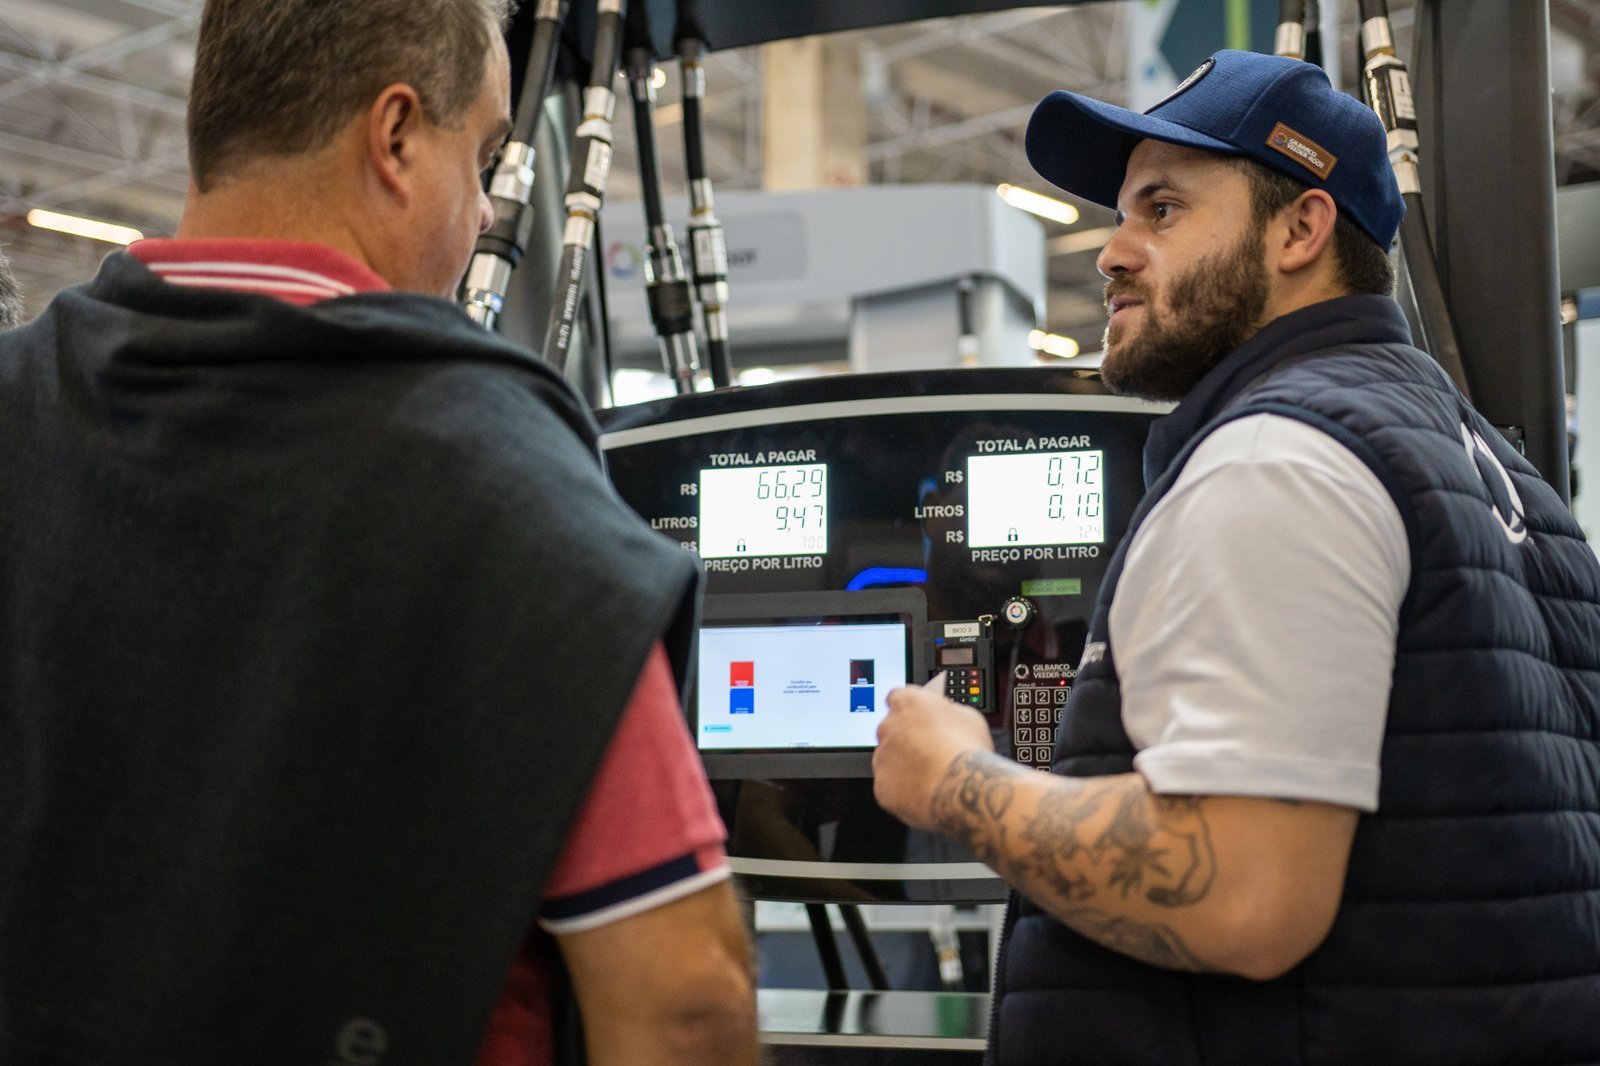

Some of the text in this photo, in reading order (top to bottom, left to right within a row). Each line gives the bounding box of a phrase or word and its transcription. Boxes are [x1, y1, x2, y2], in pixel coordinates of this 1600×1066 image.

[976, 435, 1091, 453] TOTAL A PAGAR
[710, 449, 817, 466] TOTAL A PAGAR
[945, 470, 963, 484] R$
[1047, 455, 1100, 488] 0,72
[680, 483, 698, 496] R$
[757, 469, 824, 501] 66,29
[914, 505, 964, 519] LITROS
[1048, 492, 1100, 521] 0,10
[651, 516, 698, 530] LITROS
[775, 505, 824, 532] 9,47
[946, 530, 964, 544] R$
[971, 545, 1100, 564] PREÇO POR LITRO
[704, 556, 823, 573] PREÇO POR LITRO
[1032, 663, 1070, 671] GILBARCO
[1032, 671, 1078, 679] VEEDER-ROO
[1039, 691, 1047, 702] 2
[1057, 691, 1066, 702] 3
[1039, 710, 1047, 721] 5
[1020, 730, 1028, 741] 7
[1039, 730, 1047, 741] 8
[1019, 749, 1030, 760] C
[1039, 749, 1048, 760] 0
